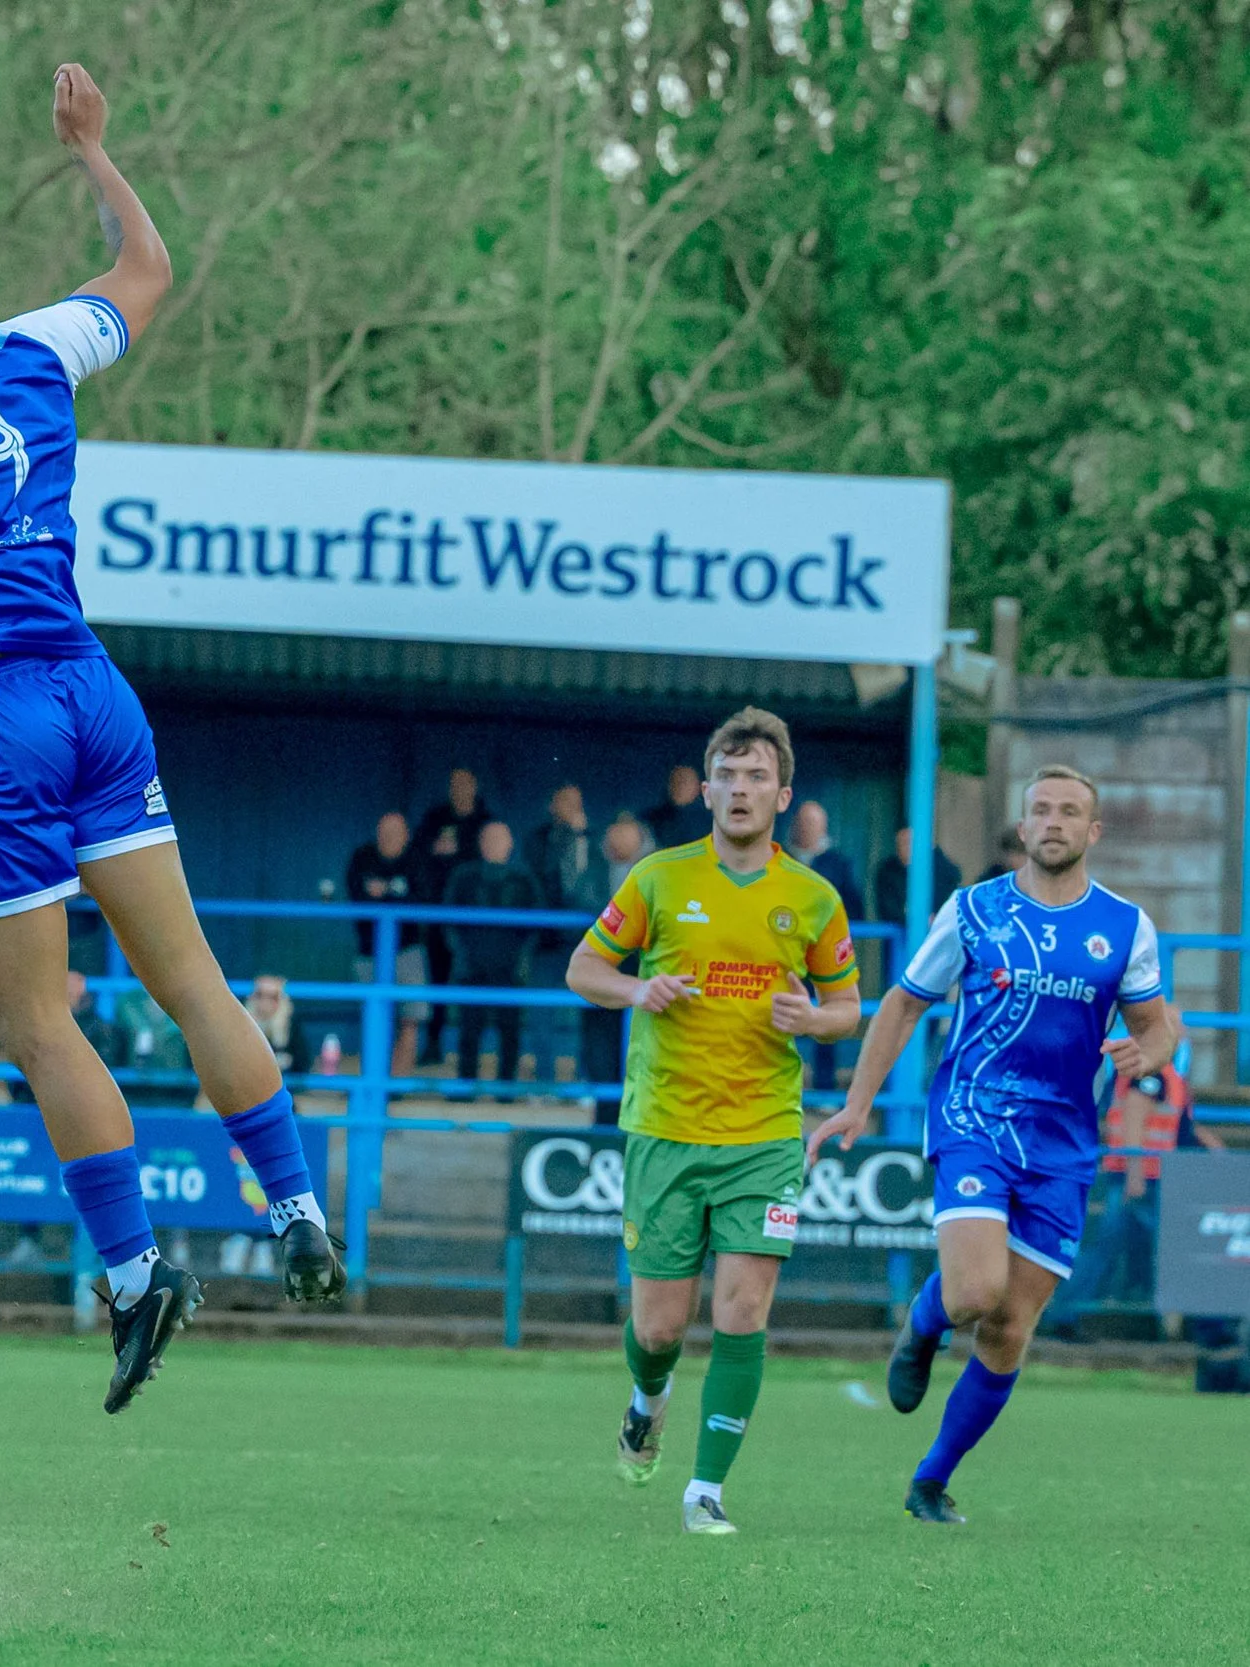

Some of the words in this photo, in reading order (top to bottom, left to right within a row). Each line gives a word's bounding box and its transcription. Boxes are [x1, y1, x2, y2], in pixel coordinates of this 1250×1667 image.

[1040, 923, 1057, 952] 3
[709, 961, 779, 977] COMPLETE
[707, 973, 771, 990] SECURITY
[1014, 968, 1097, 1003] Fidelis
[705, 986, 762, 1001] SERVICE
